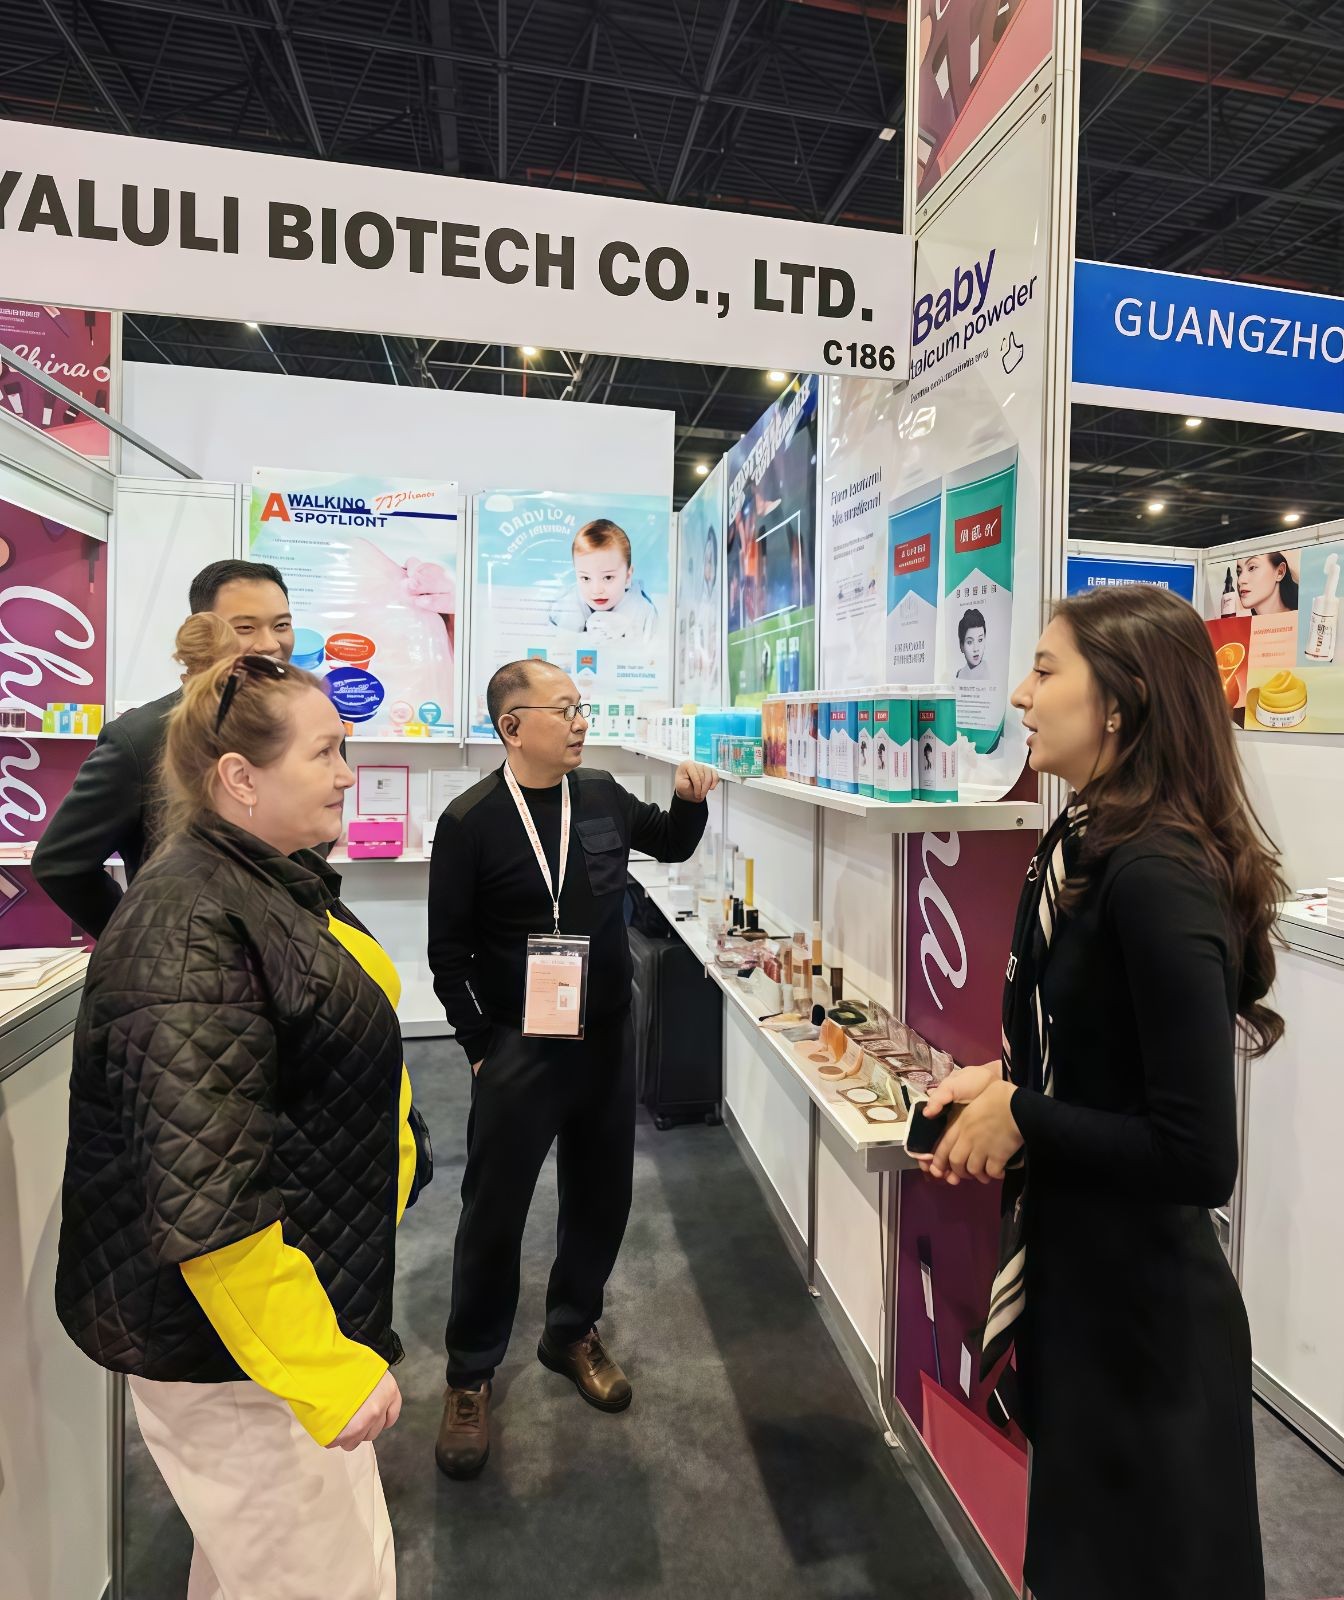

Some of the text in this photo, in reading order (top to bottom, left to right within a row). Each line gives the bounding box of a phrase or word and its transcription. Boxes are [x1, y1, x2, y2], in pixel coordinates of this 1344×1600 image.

[269, 201, 575, 291] BIOTECH
[599, 241, 730, 319] CO.,
[753, 258, 873, 322] LTD.
[912, 249, 996, 347] Baby
[964, 275, 1038, 350] powder
[1115, 297, 1344, 364] GUANGZHO
[823, 339, 896, 372] C186
[260, 492, 291, 522] A
